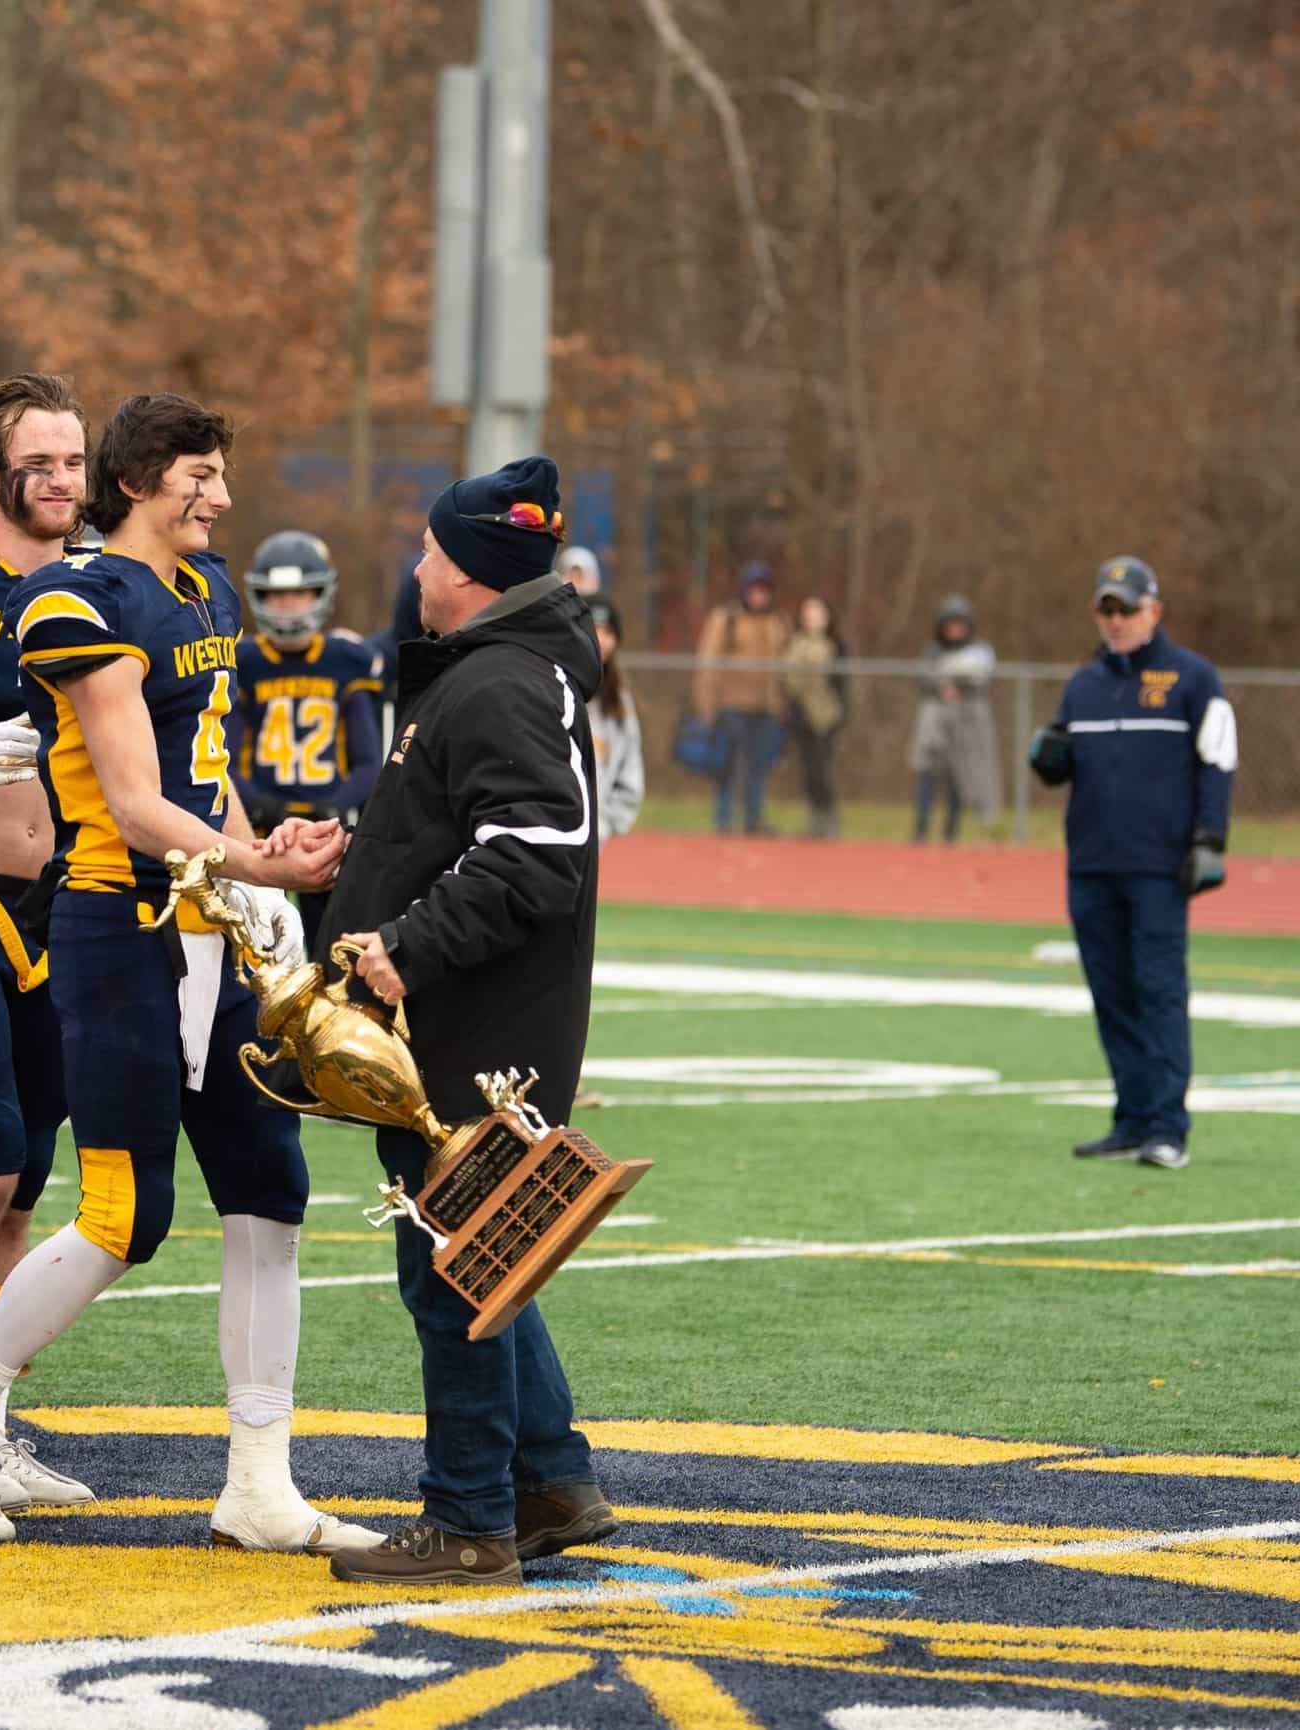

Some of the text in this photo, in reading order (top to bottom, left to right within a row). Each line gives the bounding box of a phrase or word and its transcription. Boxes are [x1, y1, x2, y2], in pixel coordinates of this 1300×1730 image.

[173, 635, 237, 678] WESTO
[190, 670, 231, 817] 4
[256, 696, 339, 786] 42
